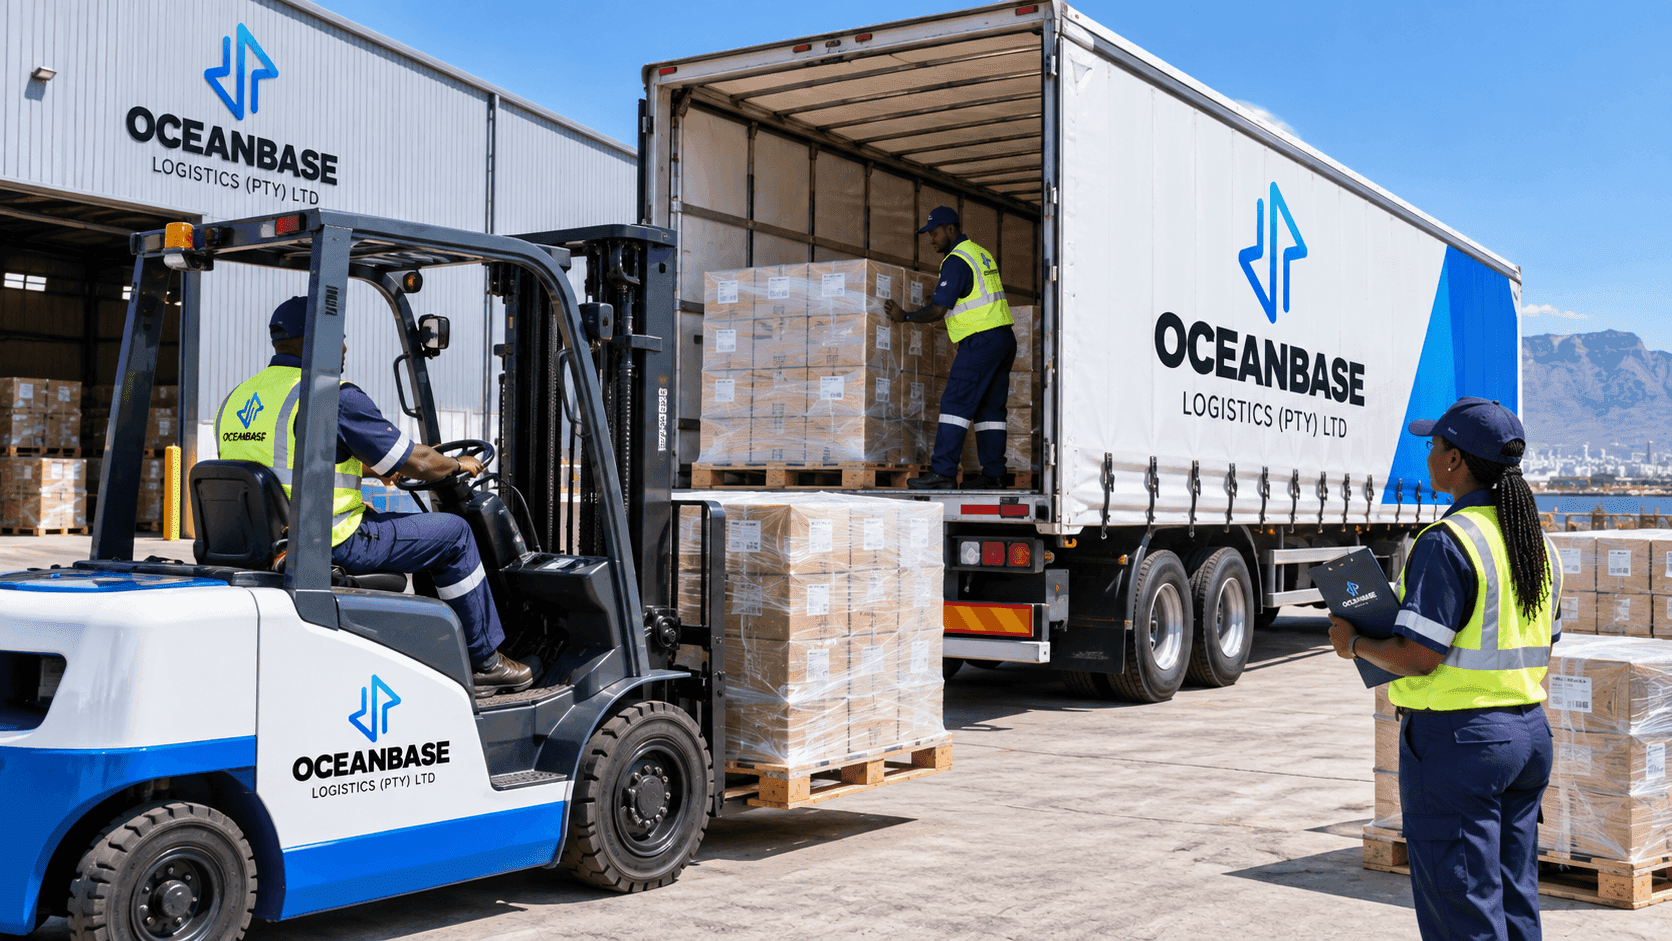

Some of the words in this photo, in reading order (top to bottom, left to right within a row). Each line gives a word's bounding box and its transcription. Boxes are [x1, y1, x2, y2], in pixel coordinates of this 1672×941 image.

[126, 106, 338, 185] OCEANBASE
[152, 156, 240, 189] LOGISTICS
[246, 176, 286, 201] (PTY)
[292, 187, 319, 205] LTD
[1154, 311, 1365, 407] OCEANBASE
[1183, 391, 1273, 427] LOGISTICS
[1279, 406, 1318, 437] (PTY)
[1323, 415, 1347, 438] LTD
[292, 740, 450, 782] OCEANBASE
[312, 780, 376, 799] LOGISTICS
[380, 775, 410, 791] (PTY)
[415, 772, 436, 785] LTD
